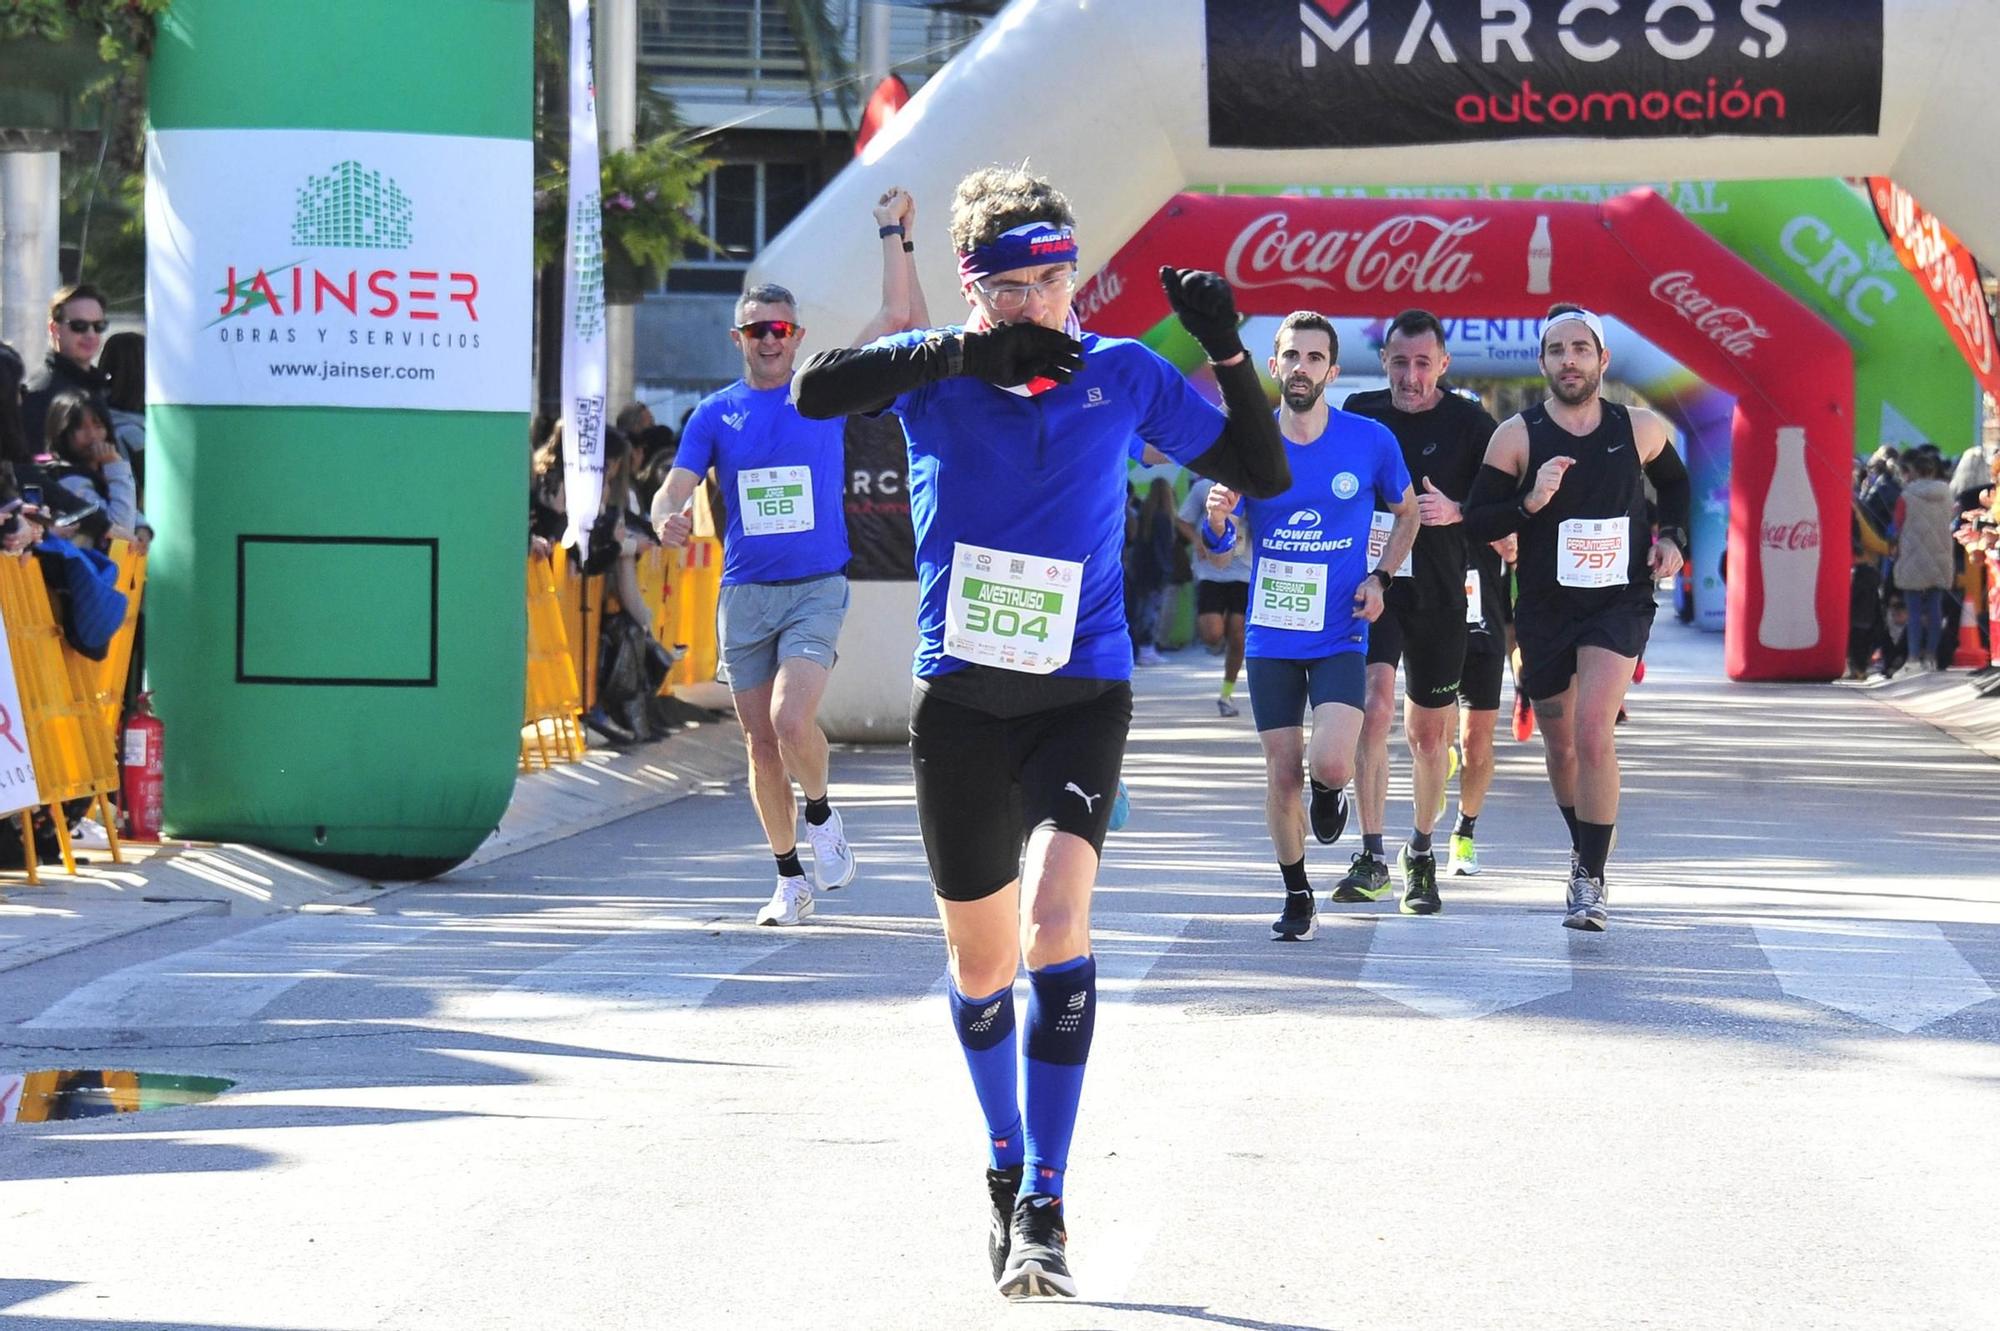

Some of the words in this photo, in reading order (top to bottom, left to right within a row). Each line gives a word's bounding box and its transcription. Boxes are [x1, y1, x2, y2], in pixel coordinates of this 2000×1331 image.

[1300, 0, 1788, 67] MARCOS
[1455, 78, 1786, 123] automoción
[1225, 213, 1491, 293] Coca-Cola
[1780, 215, 1897, 327] CRC
[219, 266, 479, 322] JAINSER
[1650, 271, 1771, 358] Coca-Cola
[220, 327, 297, 343] OBRAS
[317, 328, 328, 343] Y
[349, 328, 480, 349] SERVICIOS
[269, 362, 436, 381] www.jainser.com
[756, 499, 795, 517] 168
[1261, 536, 1353, 552] ELECTRONICS
[1273, 527, 1324, 541] POWER
[1572, 552, 1617, 569] 797
[1264, 592, 1311, 612] 249
[965, 603, 1049, 643] 304
